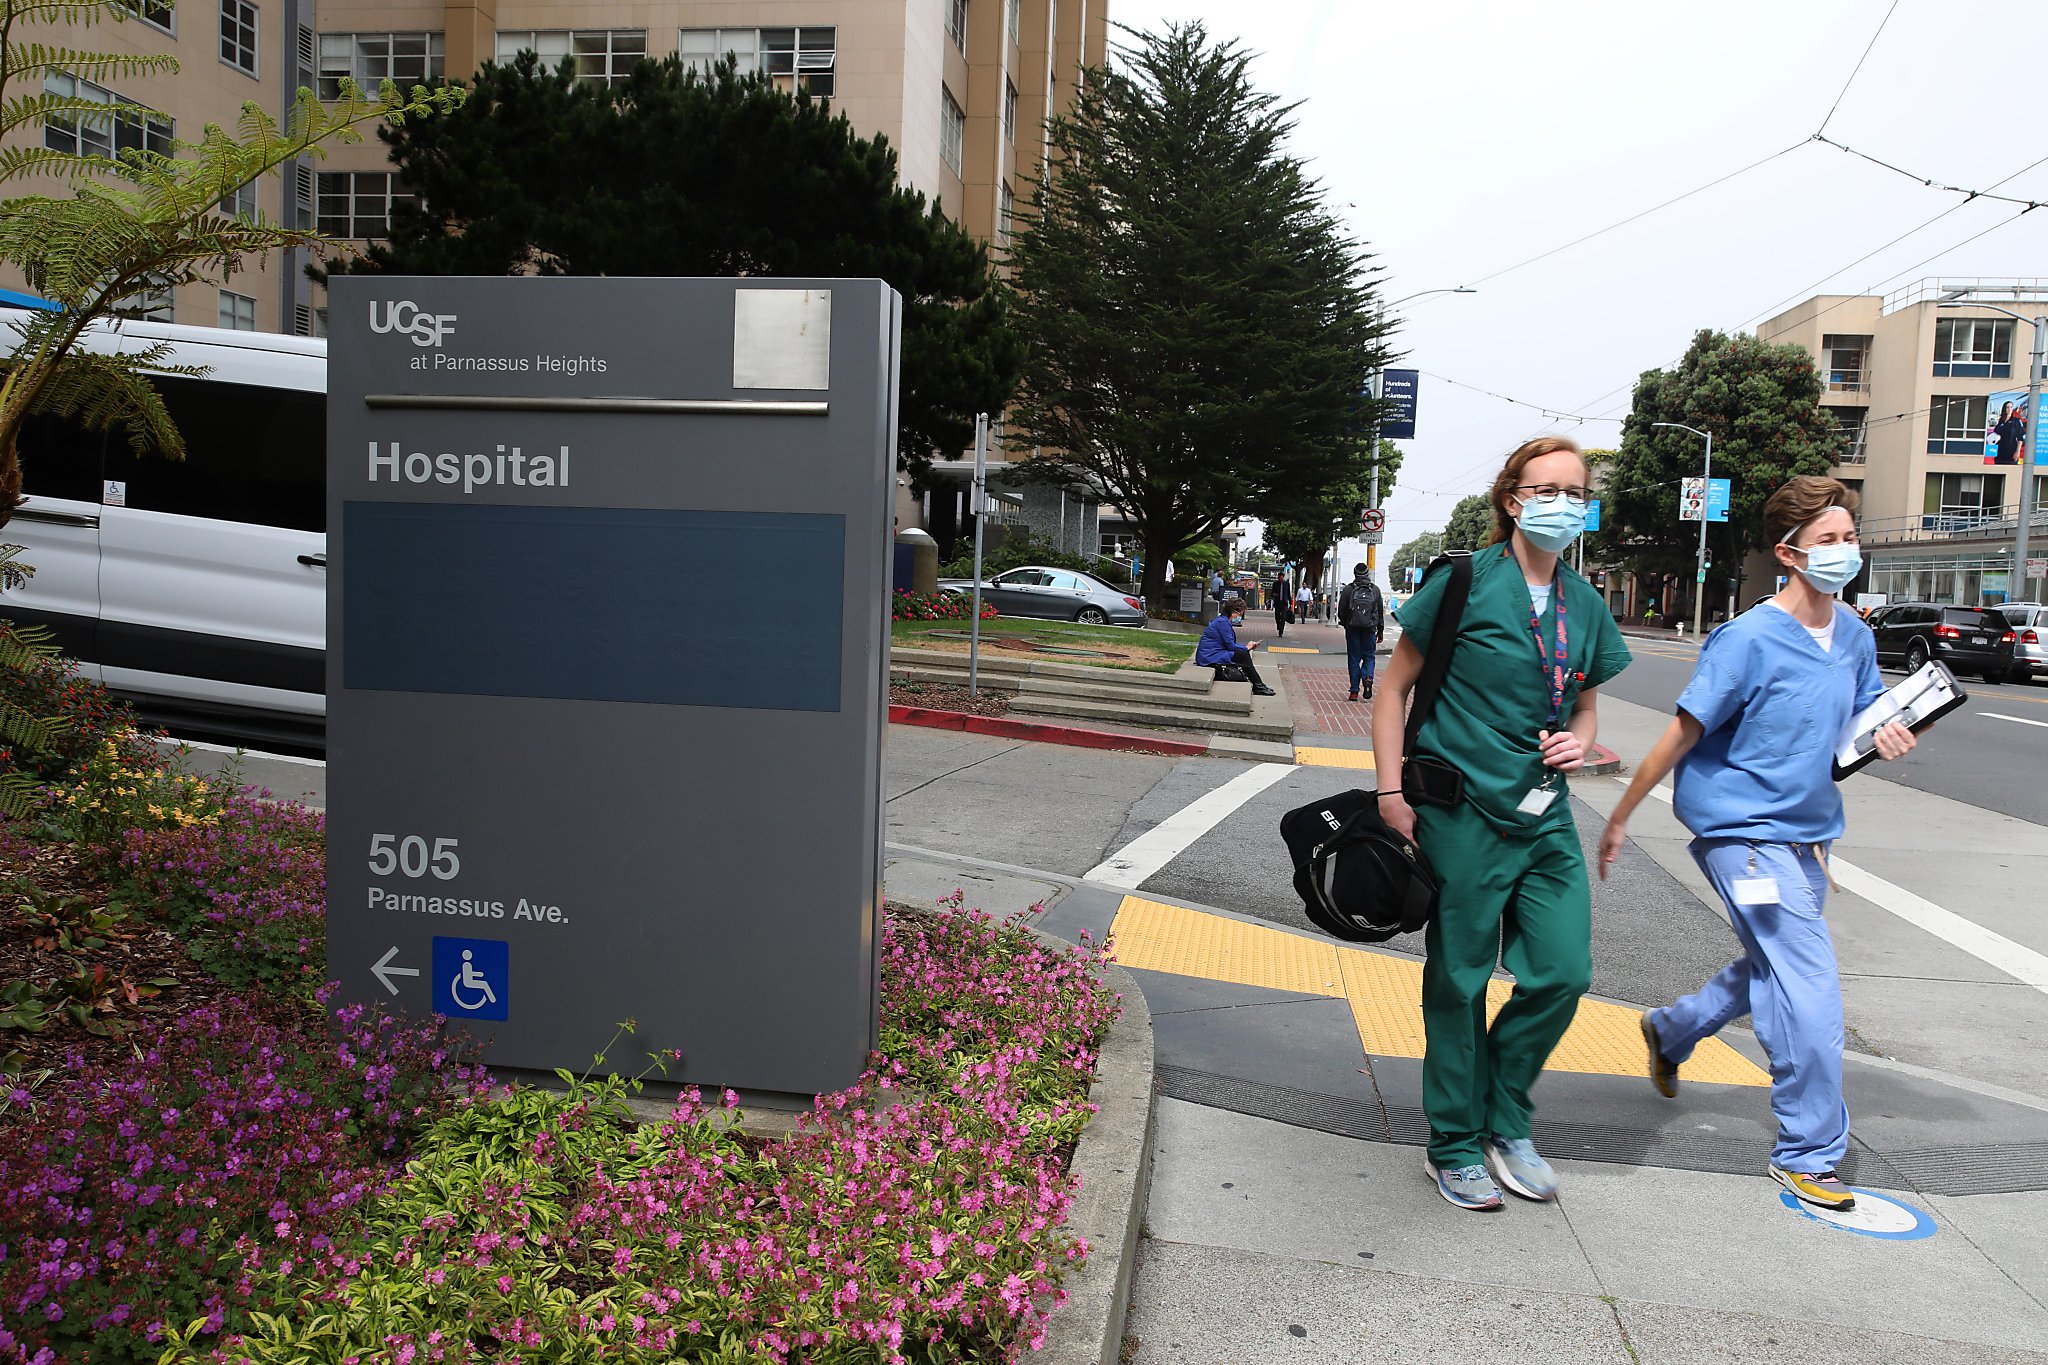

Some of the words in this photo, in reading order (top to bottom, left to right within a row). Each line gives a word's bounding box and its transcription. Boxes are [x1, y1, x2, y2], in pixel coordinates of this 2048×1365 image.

[370, 301, 457, 347] UCSF
[410, 354, 428, 370] at
[434, 353, 529, 371] Parnassus
[536, 355, 607, 376] Heights
[369, 441, 569, 494] Hospital
[368, 833, 460, 881] 505
[368, 886, 505, 919] Parnassus
[513, 898, 569, 924] Ave.
